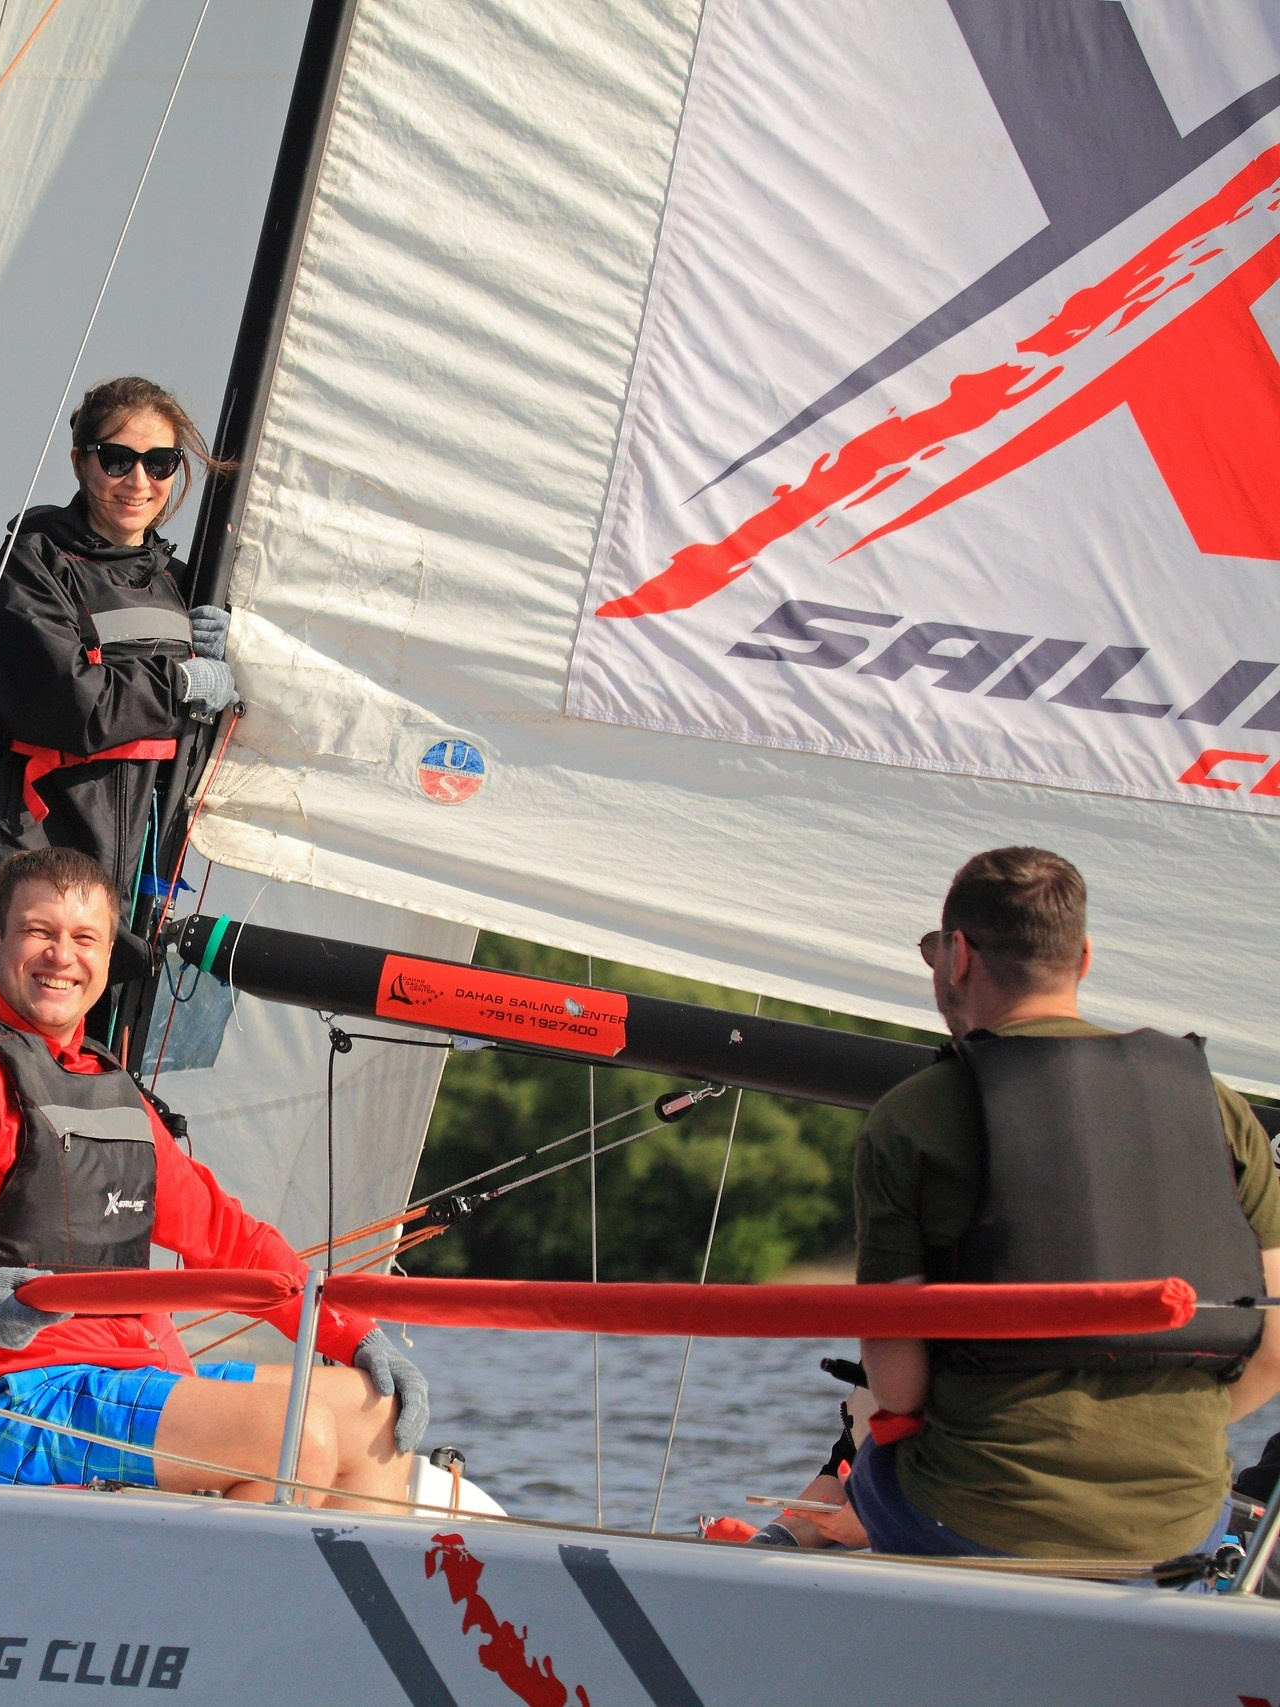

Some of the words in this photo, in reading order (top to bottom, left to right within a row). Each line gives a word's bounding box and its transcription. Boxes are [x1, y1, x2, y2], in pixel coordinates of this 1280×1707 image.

[724, 600, 1280, 733] SAILI
[455, 987, 504, 1005] DAHAB
[509, 997, 564, 1016] SAILING
[568, 1007, 627, 1024] ENTER
[479, 1009, 525, 1025] +7916
[530, 1016, 598, 1037] 1927400
[39, 1640, 190, 1690] CLUB
